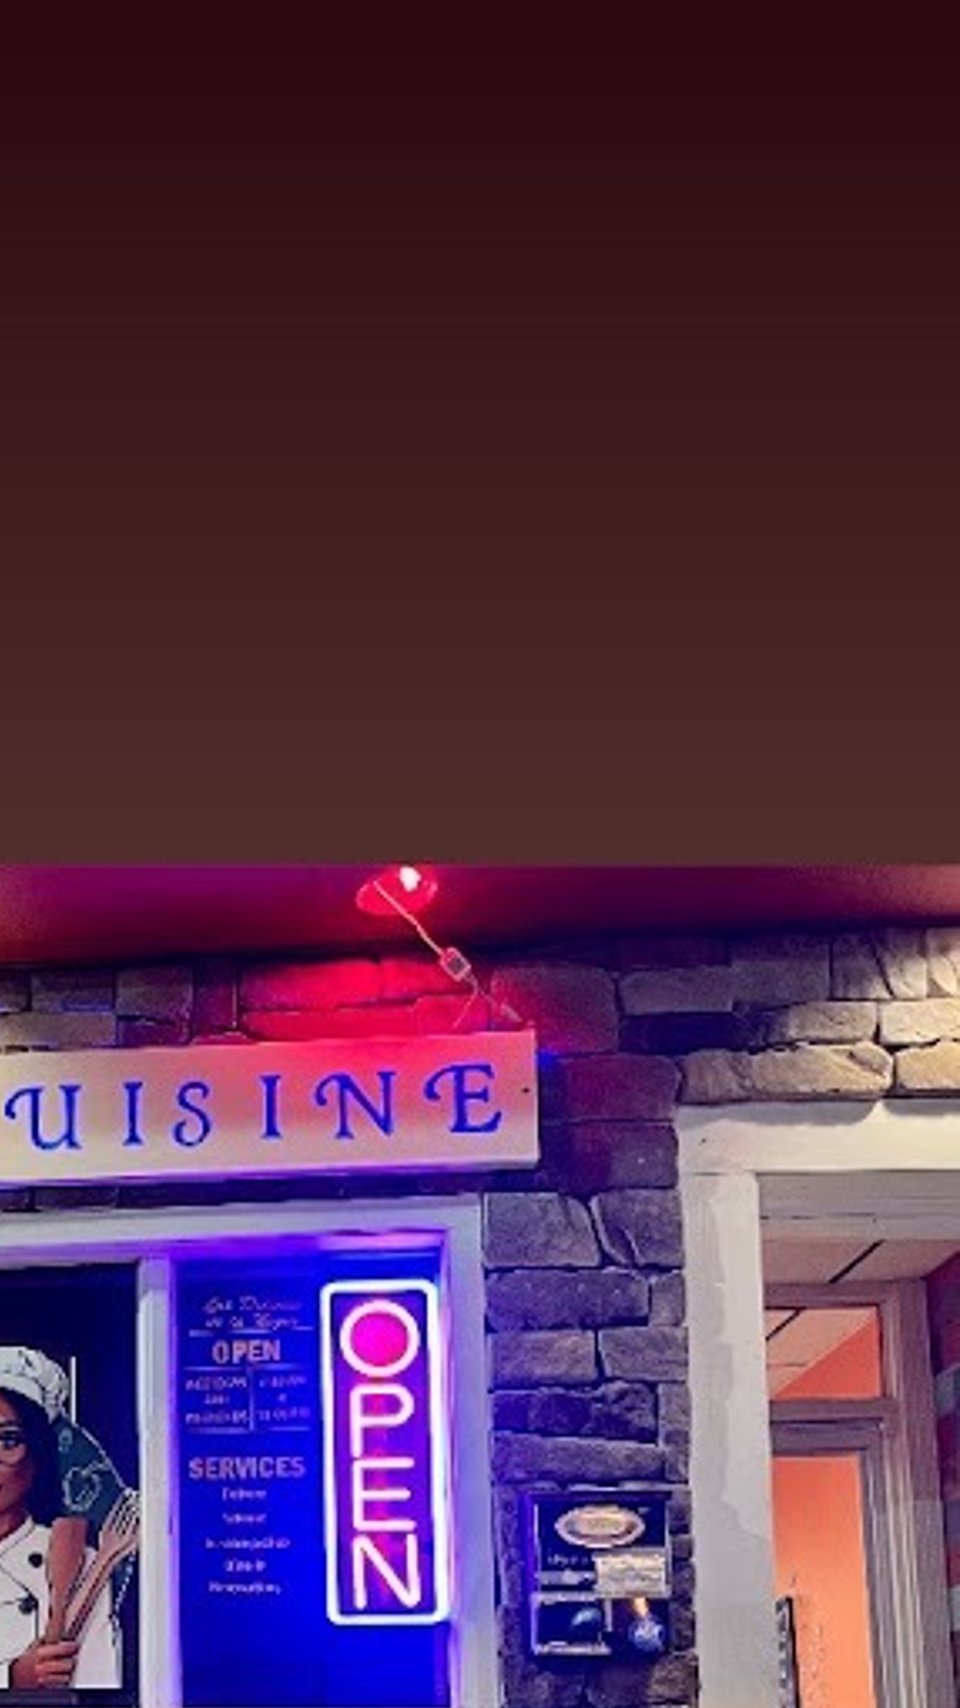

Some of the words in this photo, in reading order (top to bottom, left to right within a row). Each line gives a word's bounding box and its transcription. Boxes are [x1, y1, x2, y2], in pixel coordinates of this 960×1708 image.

[211, 1339, 281, 1364] OPEN
[339, 1299, 422, 1610] OPEN
[188, 1456, 307, 1479] SERVICES
